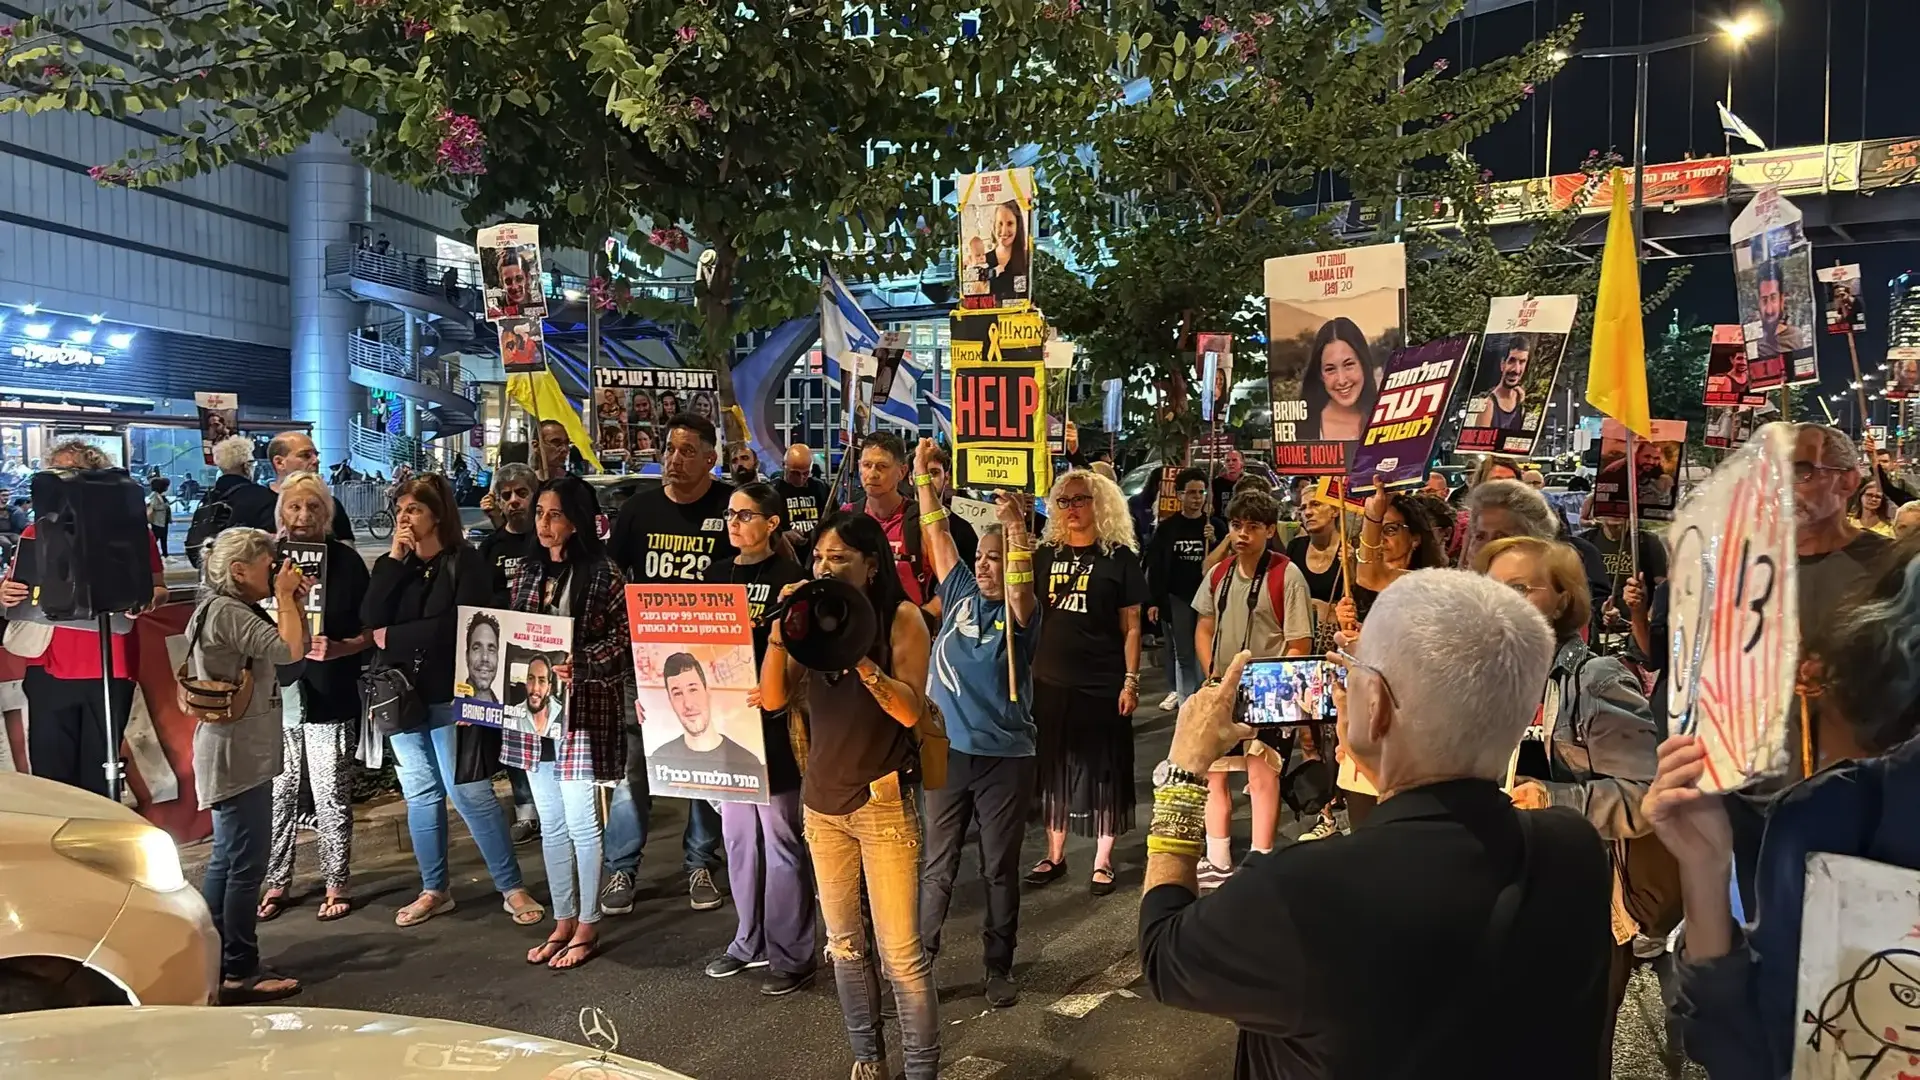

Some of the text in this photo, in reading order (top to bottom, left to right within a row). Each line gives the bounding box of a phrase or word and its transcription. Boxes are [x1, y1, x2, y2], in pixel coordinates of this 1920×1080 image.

[1308, 266, 1354, 282] NAAMA LEVY
[1341, 281, 1353, 292] 20
[999, 321, 1045, 341] אמא!!!
[595, 368, 714, 390] זועקות בשבילן
[1384, 359, 1454, 391] המלחמה
[955, 375, 1040, 439] HELP
[1372, 382, 1447, 424] רעה
[1273, 400, 1308, 421] BRING
[1274, 422, 1297, 442] HER
[1364, 416, 1434, 446] לחטופים
[1275, 442, 1345, 465] HOME NOW!
[975, 455, 1018, 467] תינוק חטוף
[987, 468, 1008, 478] בעזה
[957, 503, 987, 517] STOP
[647, 533, 716, 554] 7 באוקטובר
[645, 551, 712, 581] 06:29
[637, 592, 735, 609] איתי סבירסקי
[640, 611, 661, 621] בשבי
[662, 611, 679, 621] ימים
[681, 611, 692, 621] 99
[693, 612, 714, 622] אחרי
[637, 623, 666, 635] האחרון
[667, 623, 679, 633] לא
[699, 624, 729, 636] הראשון
[731, 624, 743, 634] לא
[513, 632, 530, 641] MATAN
[462, 703, 485, 721] BRING
[504, 704, 527, 718] BRING
[733, 774, 760, 788] מתי
